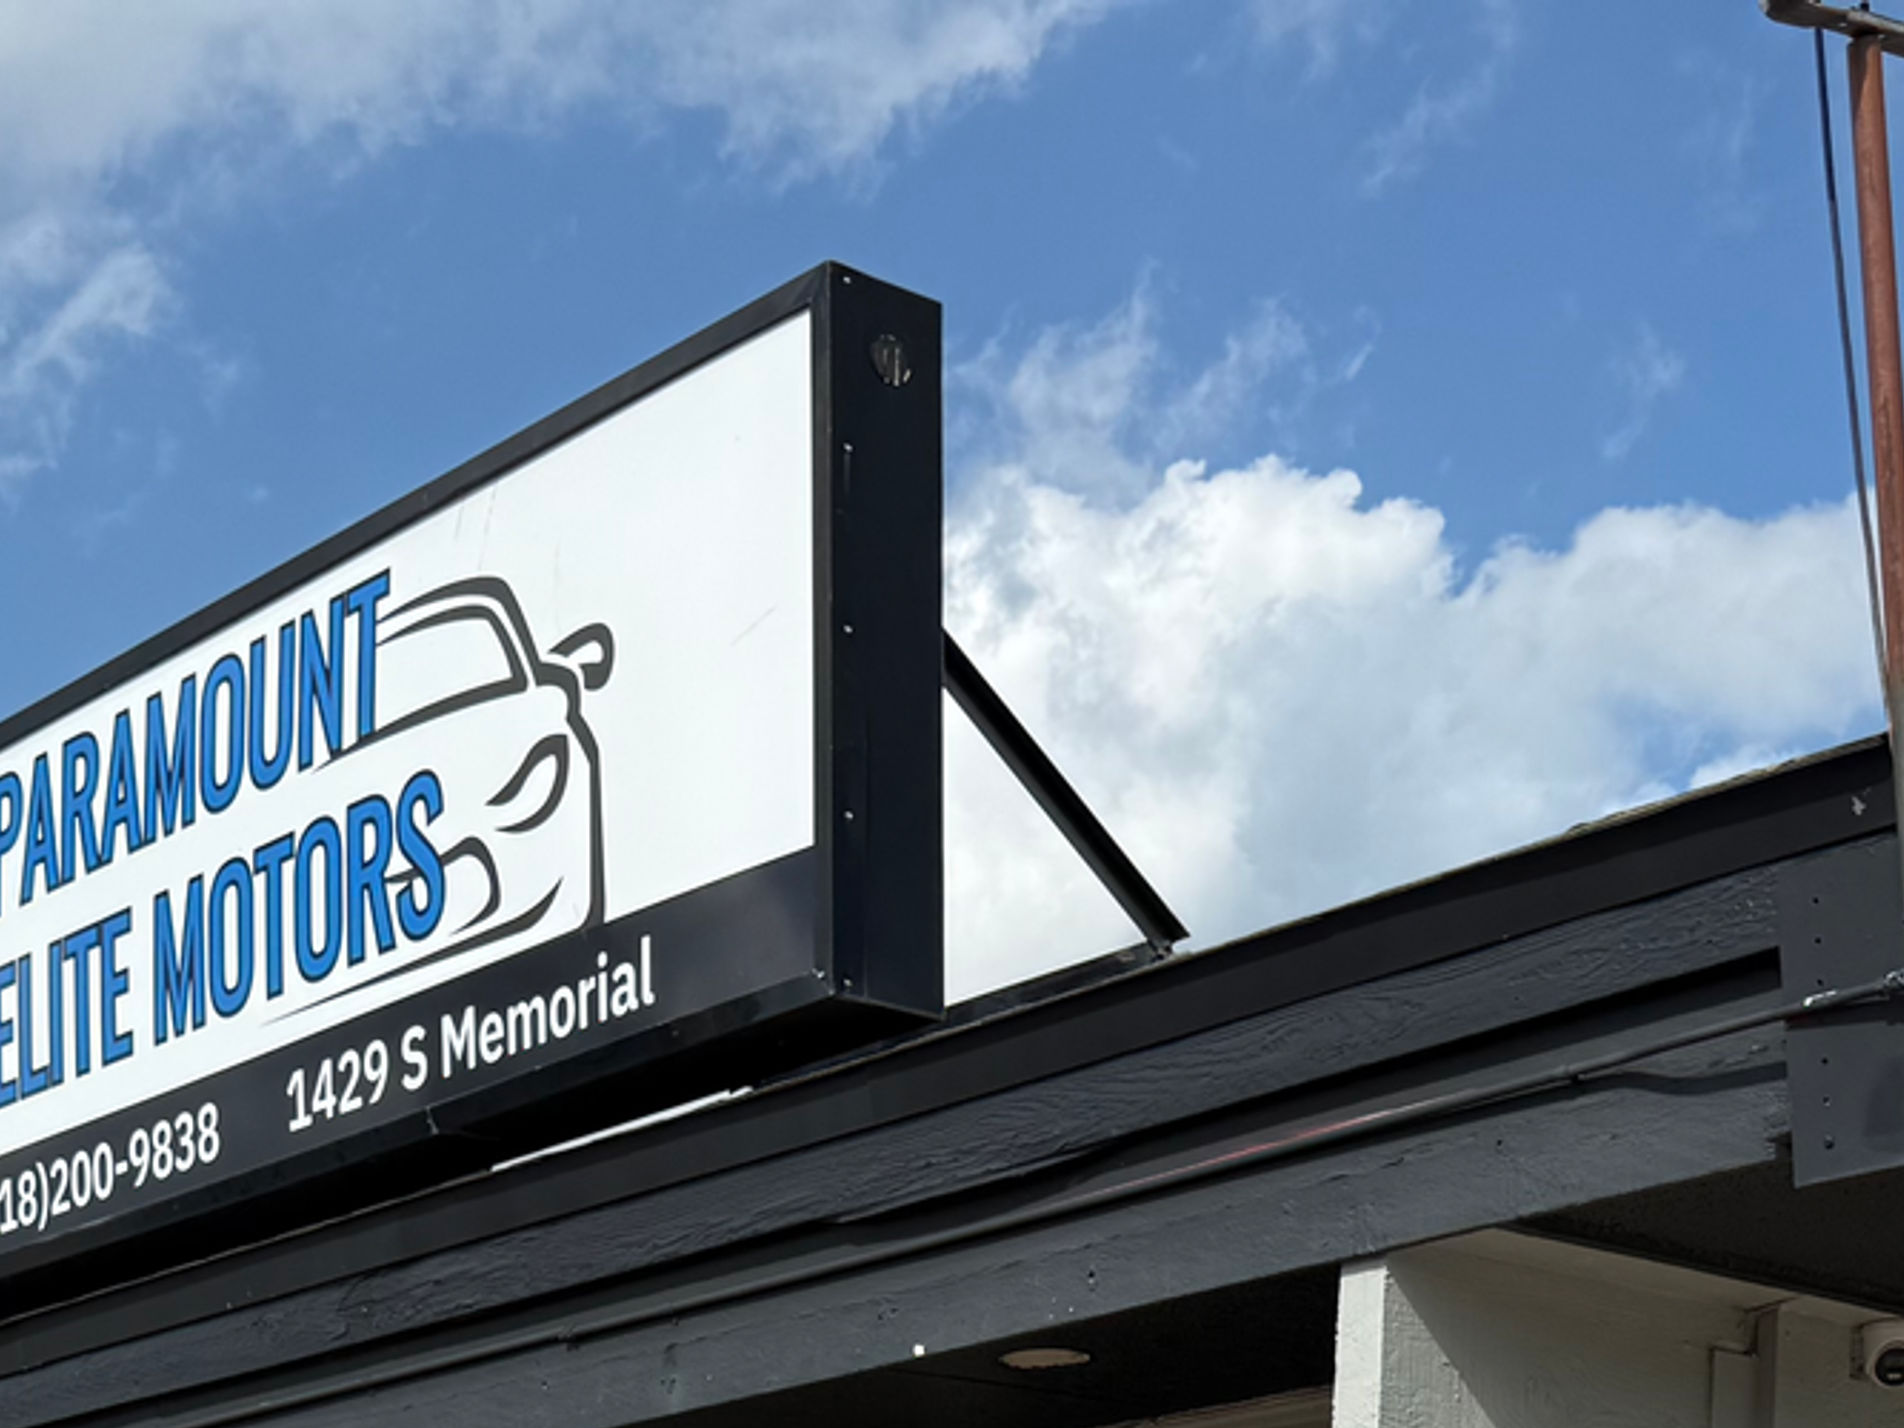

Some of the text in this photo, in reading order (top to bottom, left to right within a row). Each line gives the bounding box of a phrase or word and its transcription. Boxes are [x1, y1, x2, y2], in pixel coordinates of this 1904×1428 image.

[153, 769, 445, 1045] MOTORS
[286, 935, 655, 1132] 1429 S Memorial
